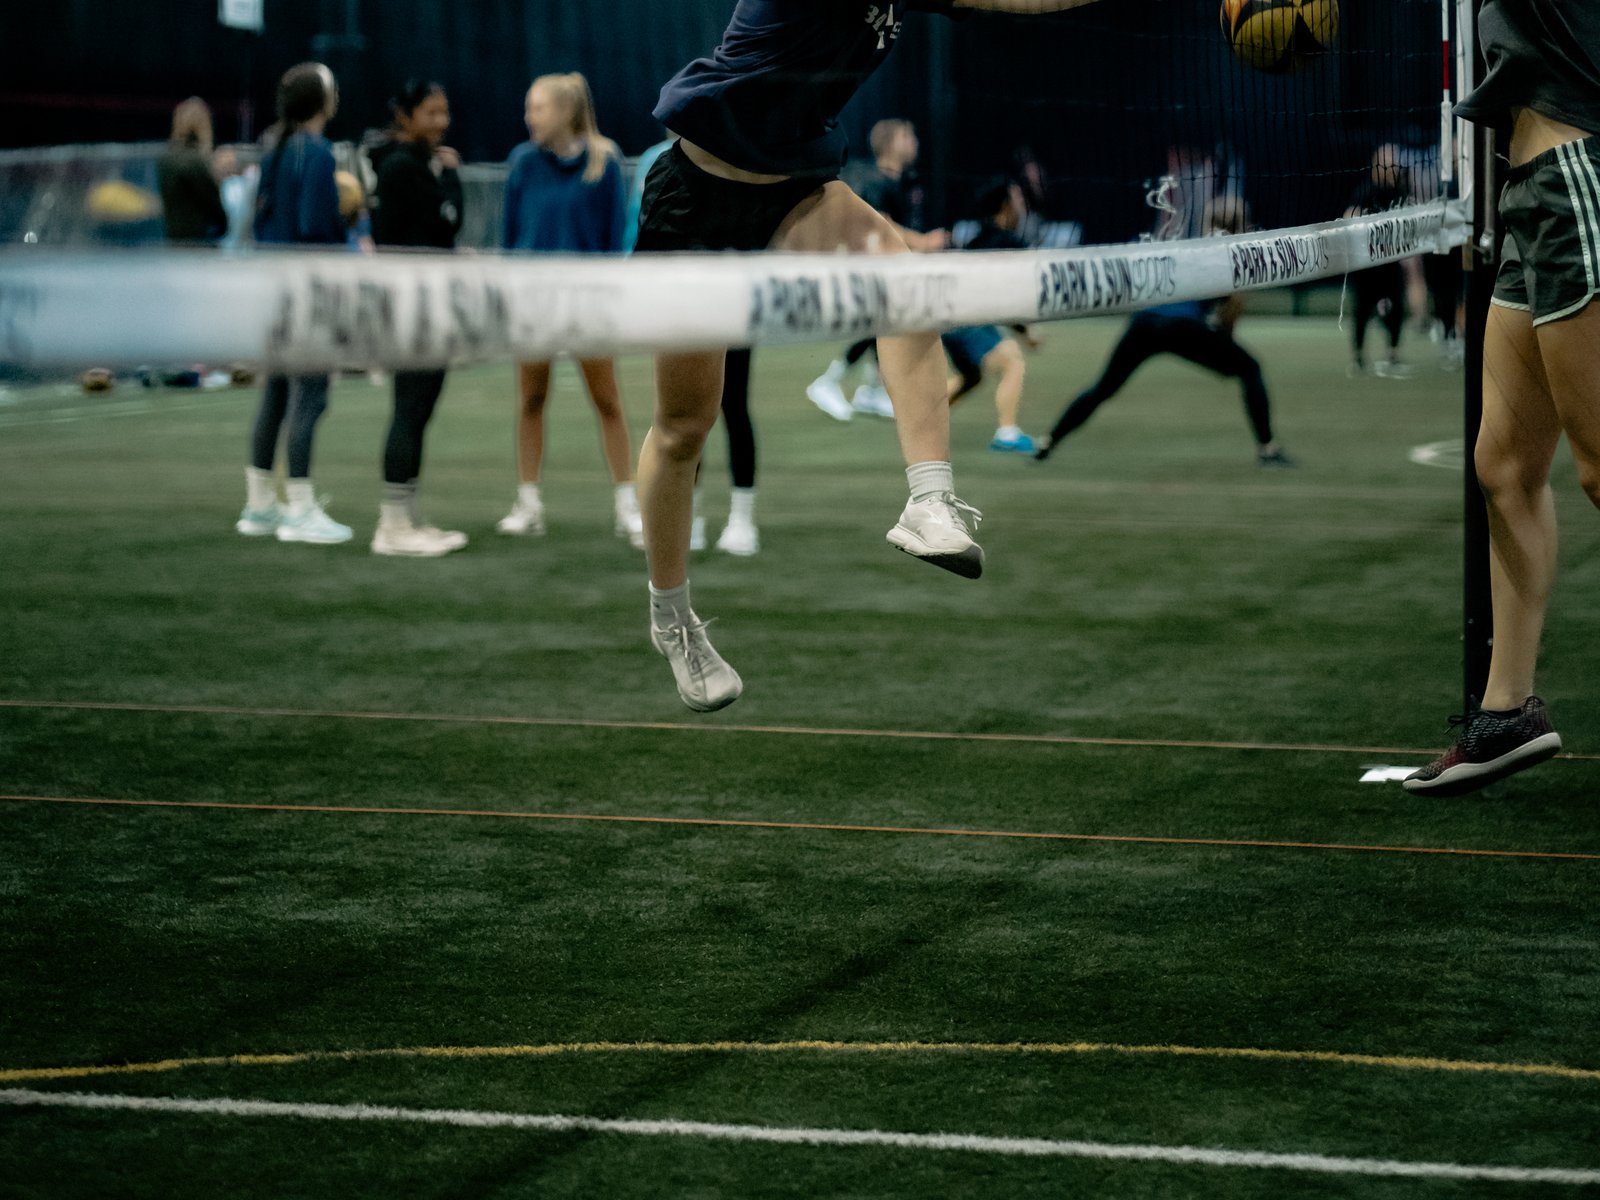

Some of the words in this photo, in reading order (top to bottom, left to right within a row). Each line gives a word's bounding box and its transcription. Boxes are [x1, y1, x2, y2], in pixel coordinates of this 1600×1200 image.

[1049, 259, 1088, 311] PARK
[1237, 243, 1268, 286] PARK
[1267, 243, 1277, 281] &
